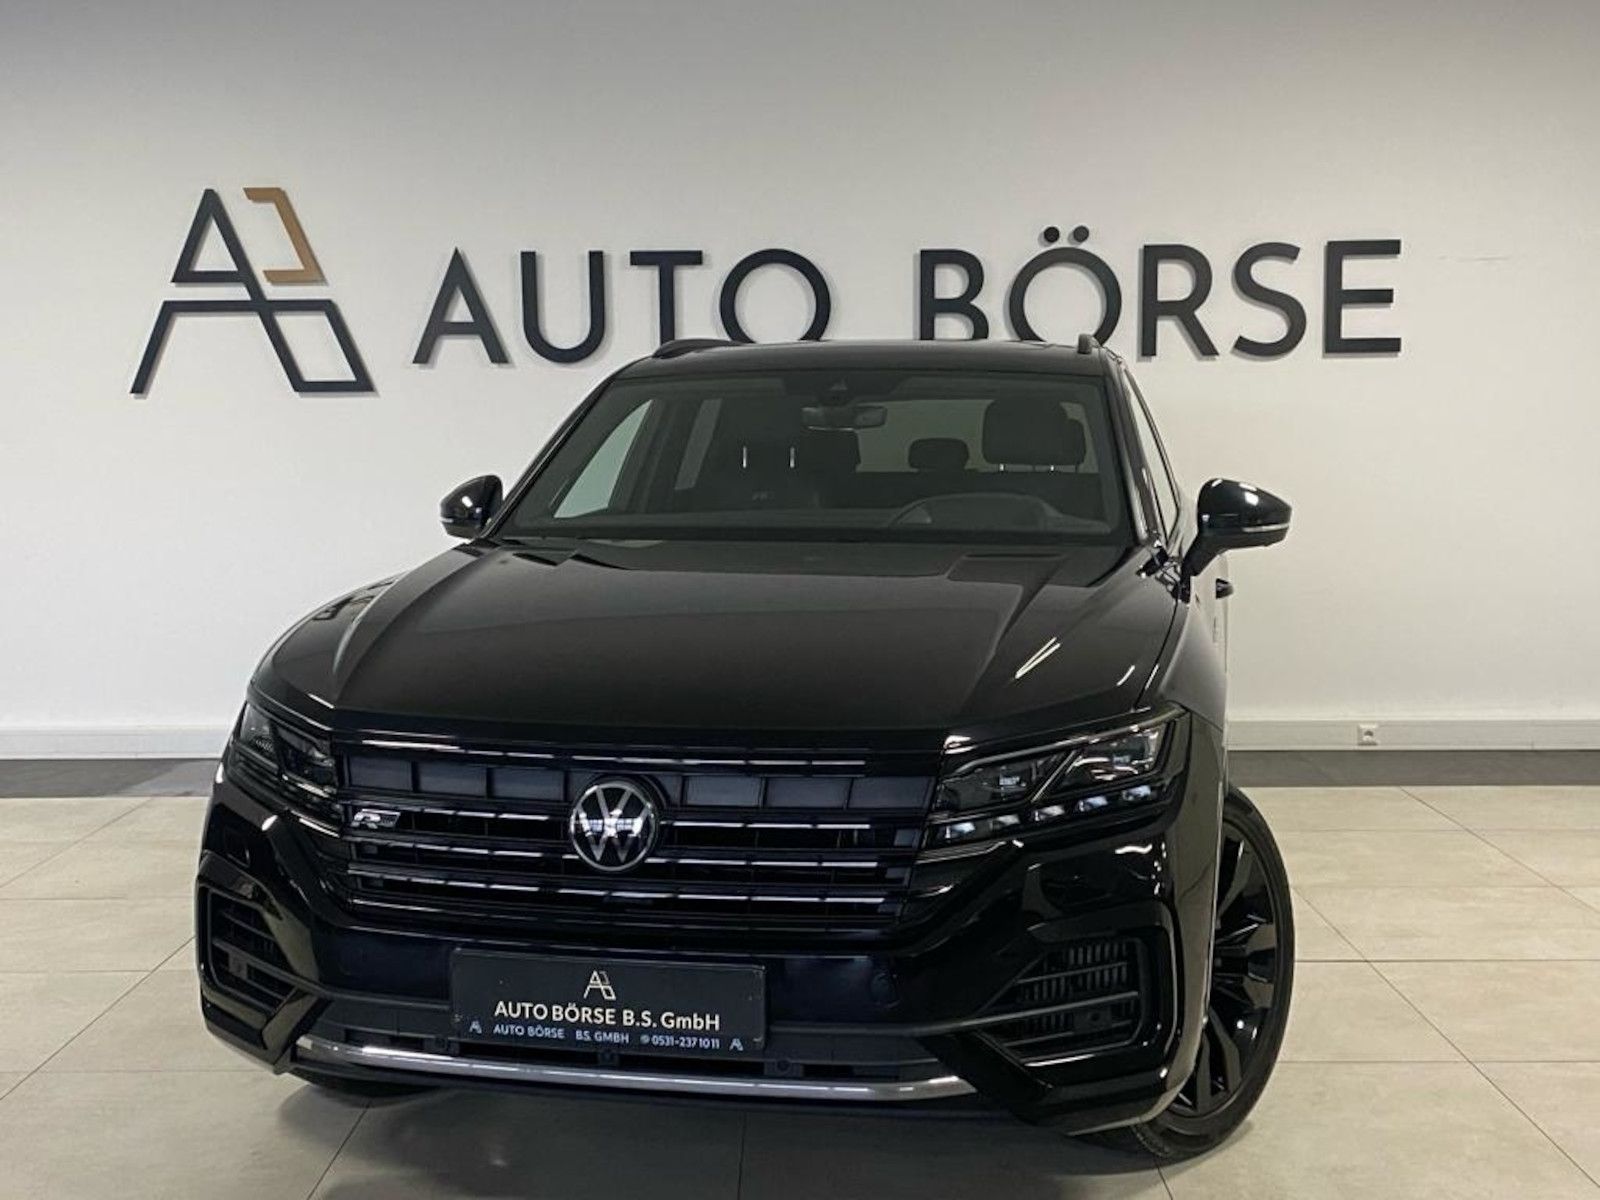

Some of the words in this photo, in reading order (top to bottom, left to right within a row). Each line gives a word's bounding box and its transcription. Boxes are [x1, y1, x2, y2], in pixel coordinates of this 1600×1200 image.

[413, 246, 831, 364] AUTO
[918, 225, 1402, 357] BÖRSE
[494, 1000, 549, 1020] AUTO
[551, 1002, 616, 1025] BÖRSE
[622, 1009, 658, 1028] B.S.
[661, 1012, 720, 1032] GmbH
[493, 1024, 525, 1036] AUTO
[527, 1025, 566, 1039] BÖRSE
[594, 1031, 630, 1044] GMBH
